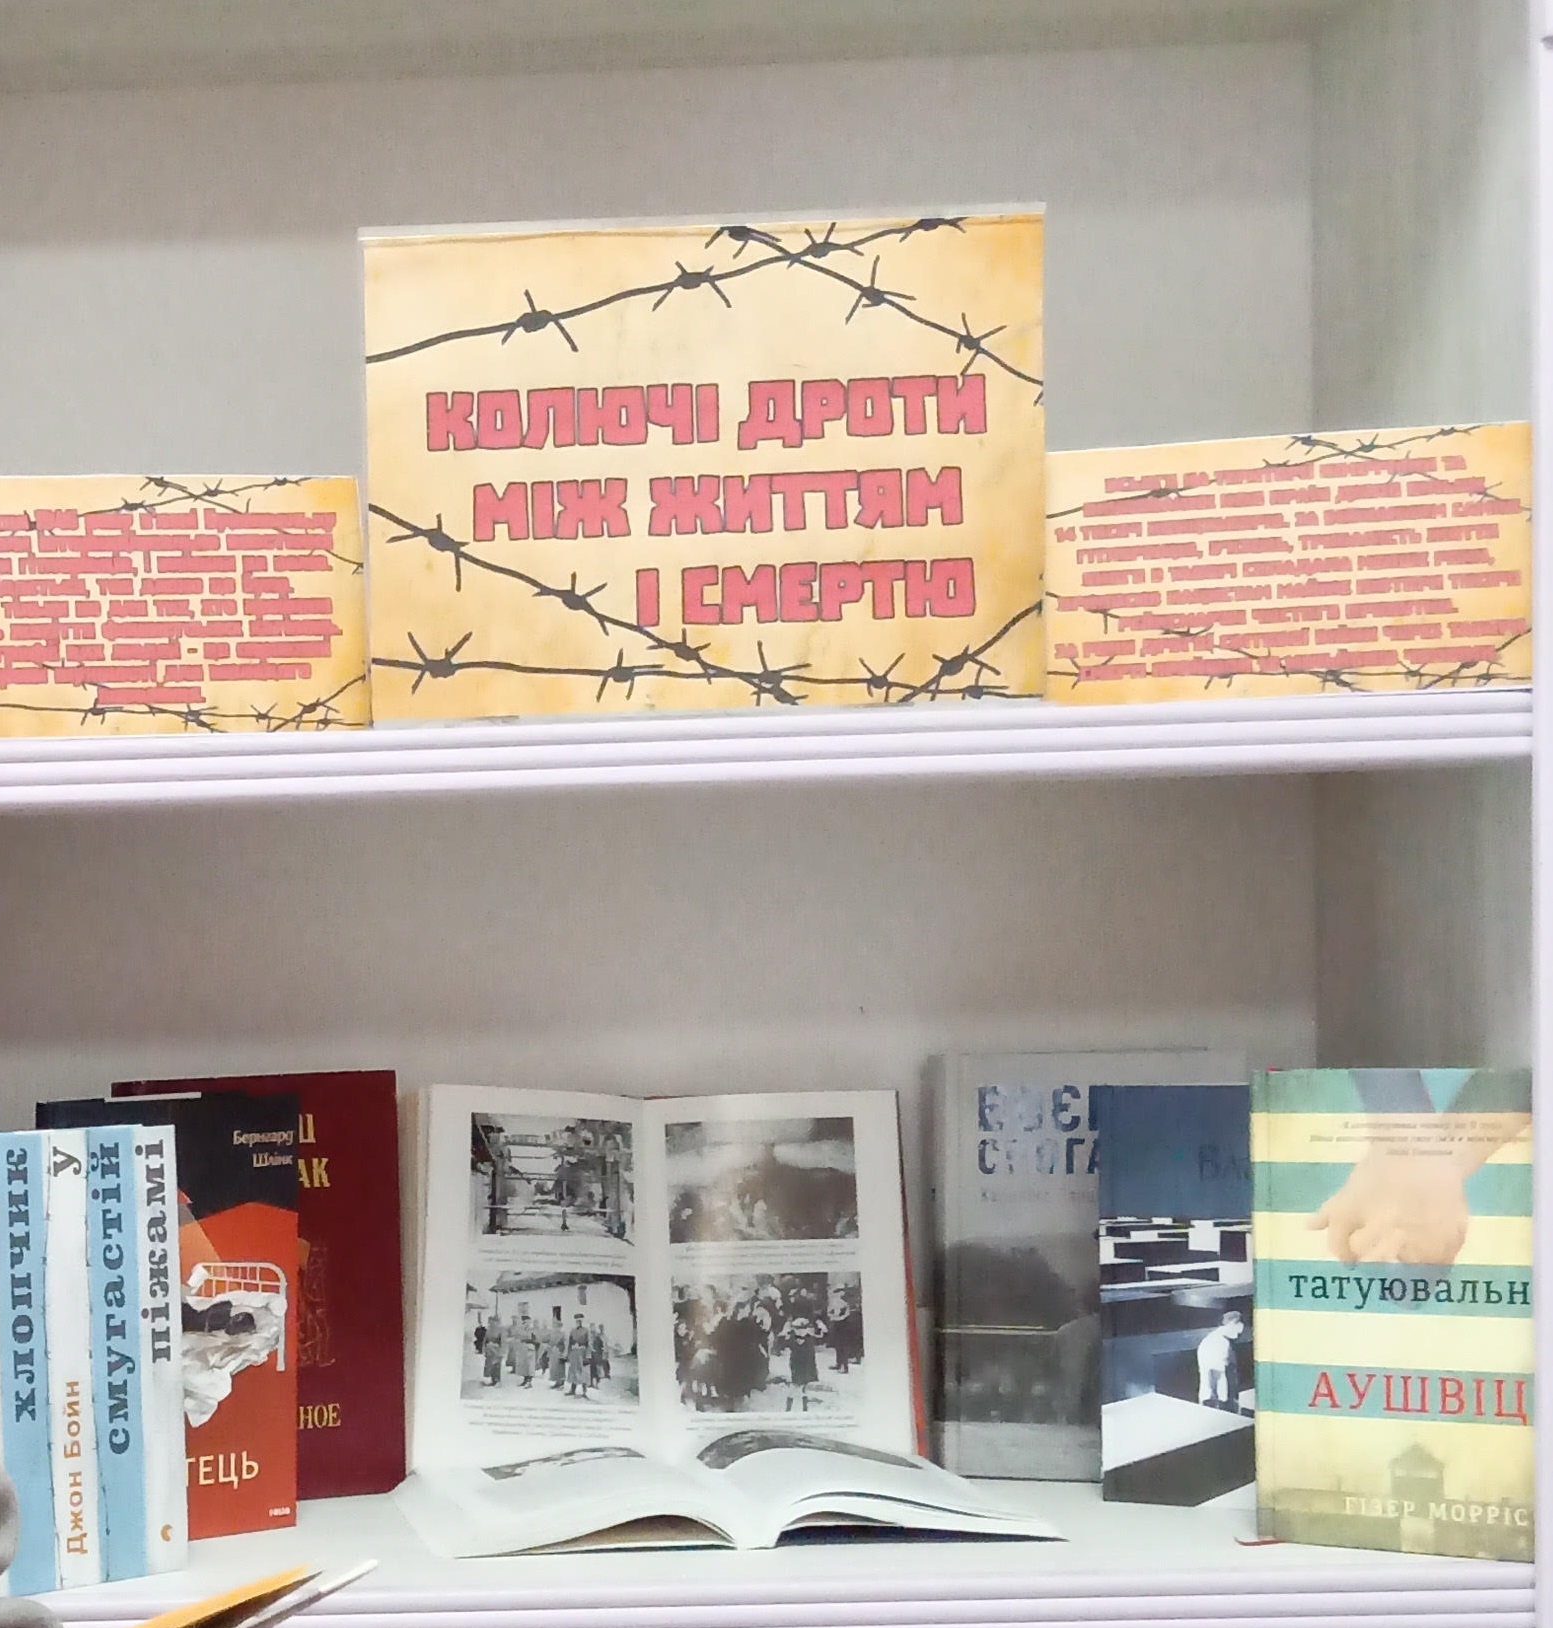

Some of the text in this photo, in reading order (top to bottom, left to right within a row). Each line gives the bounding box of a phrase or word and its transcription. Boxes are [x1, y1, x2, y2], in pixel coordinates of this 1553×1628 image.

[426, 373, 987, 452] КОЛЮЧІ ДРОТИ
[473, 466, 963, 542] МІЖ ЖИТТЯМ
[636, 557, 976, 628] І СМЕРТЮ
[91, 1142, 136, 1454] смугастій
[135, 1139, 171, 1363] піжамі
[1288, 1274, 1530, 1310] татуювальн
[1308, 1372, 1528, 1426] АУШВІЦ
[67, 1471, 88, 1555] Джон
[1428, 1502, 1529, 1526] МОРРІС
